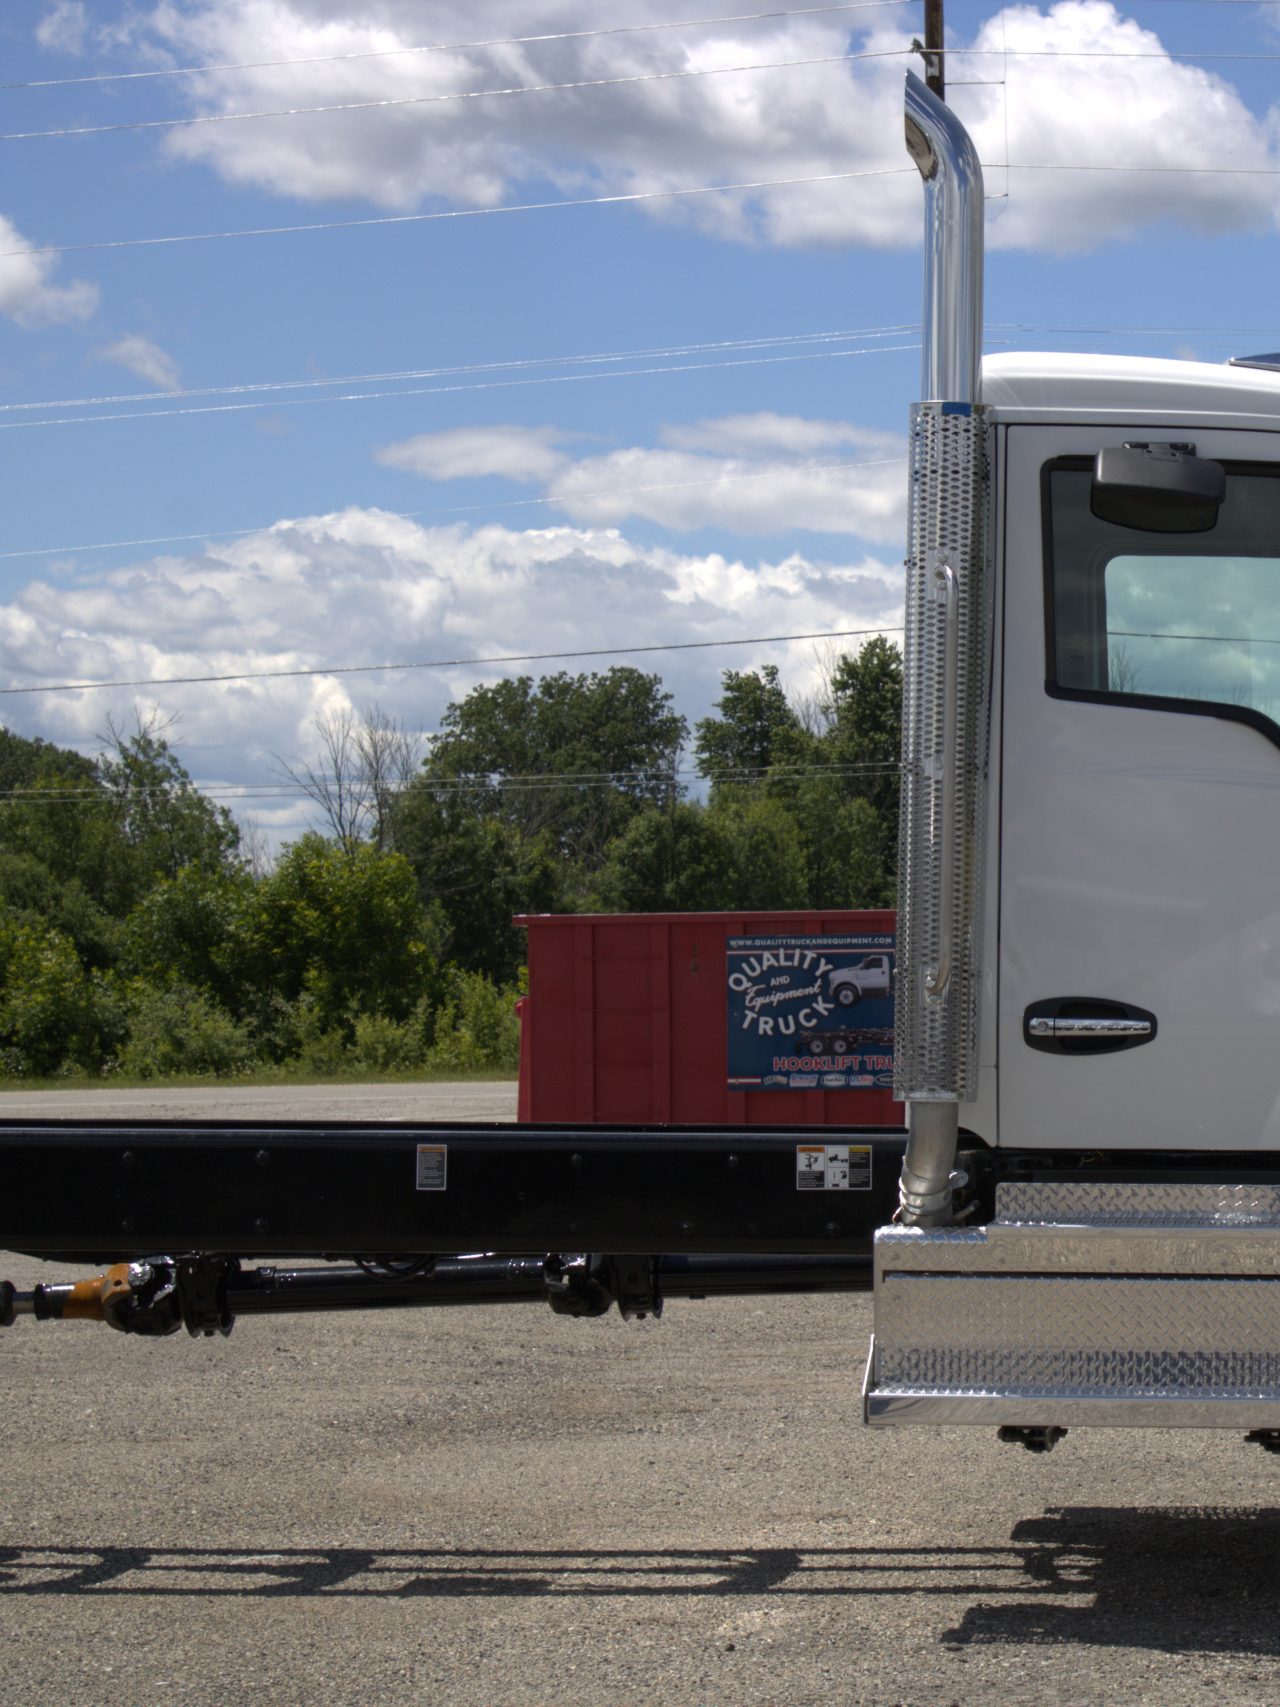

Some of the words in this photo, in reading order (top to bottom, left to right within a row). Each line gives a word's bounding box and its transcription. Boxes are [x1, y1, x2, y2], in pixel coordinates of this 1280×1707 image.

[729, 937, 892, 947] WWW.QUALITYTRUCKANDEQUIPMENT.COM
[728, 948, 834, 991] QUALITY
[770, 975, 790, 987] AND
[744, 978, 822, 1012] Equipment
[742, 995, 835, 1036] TRUCK
[772, 1056, 861, 1071] HOOKLIFT
